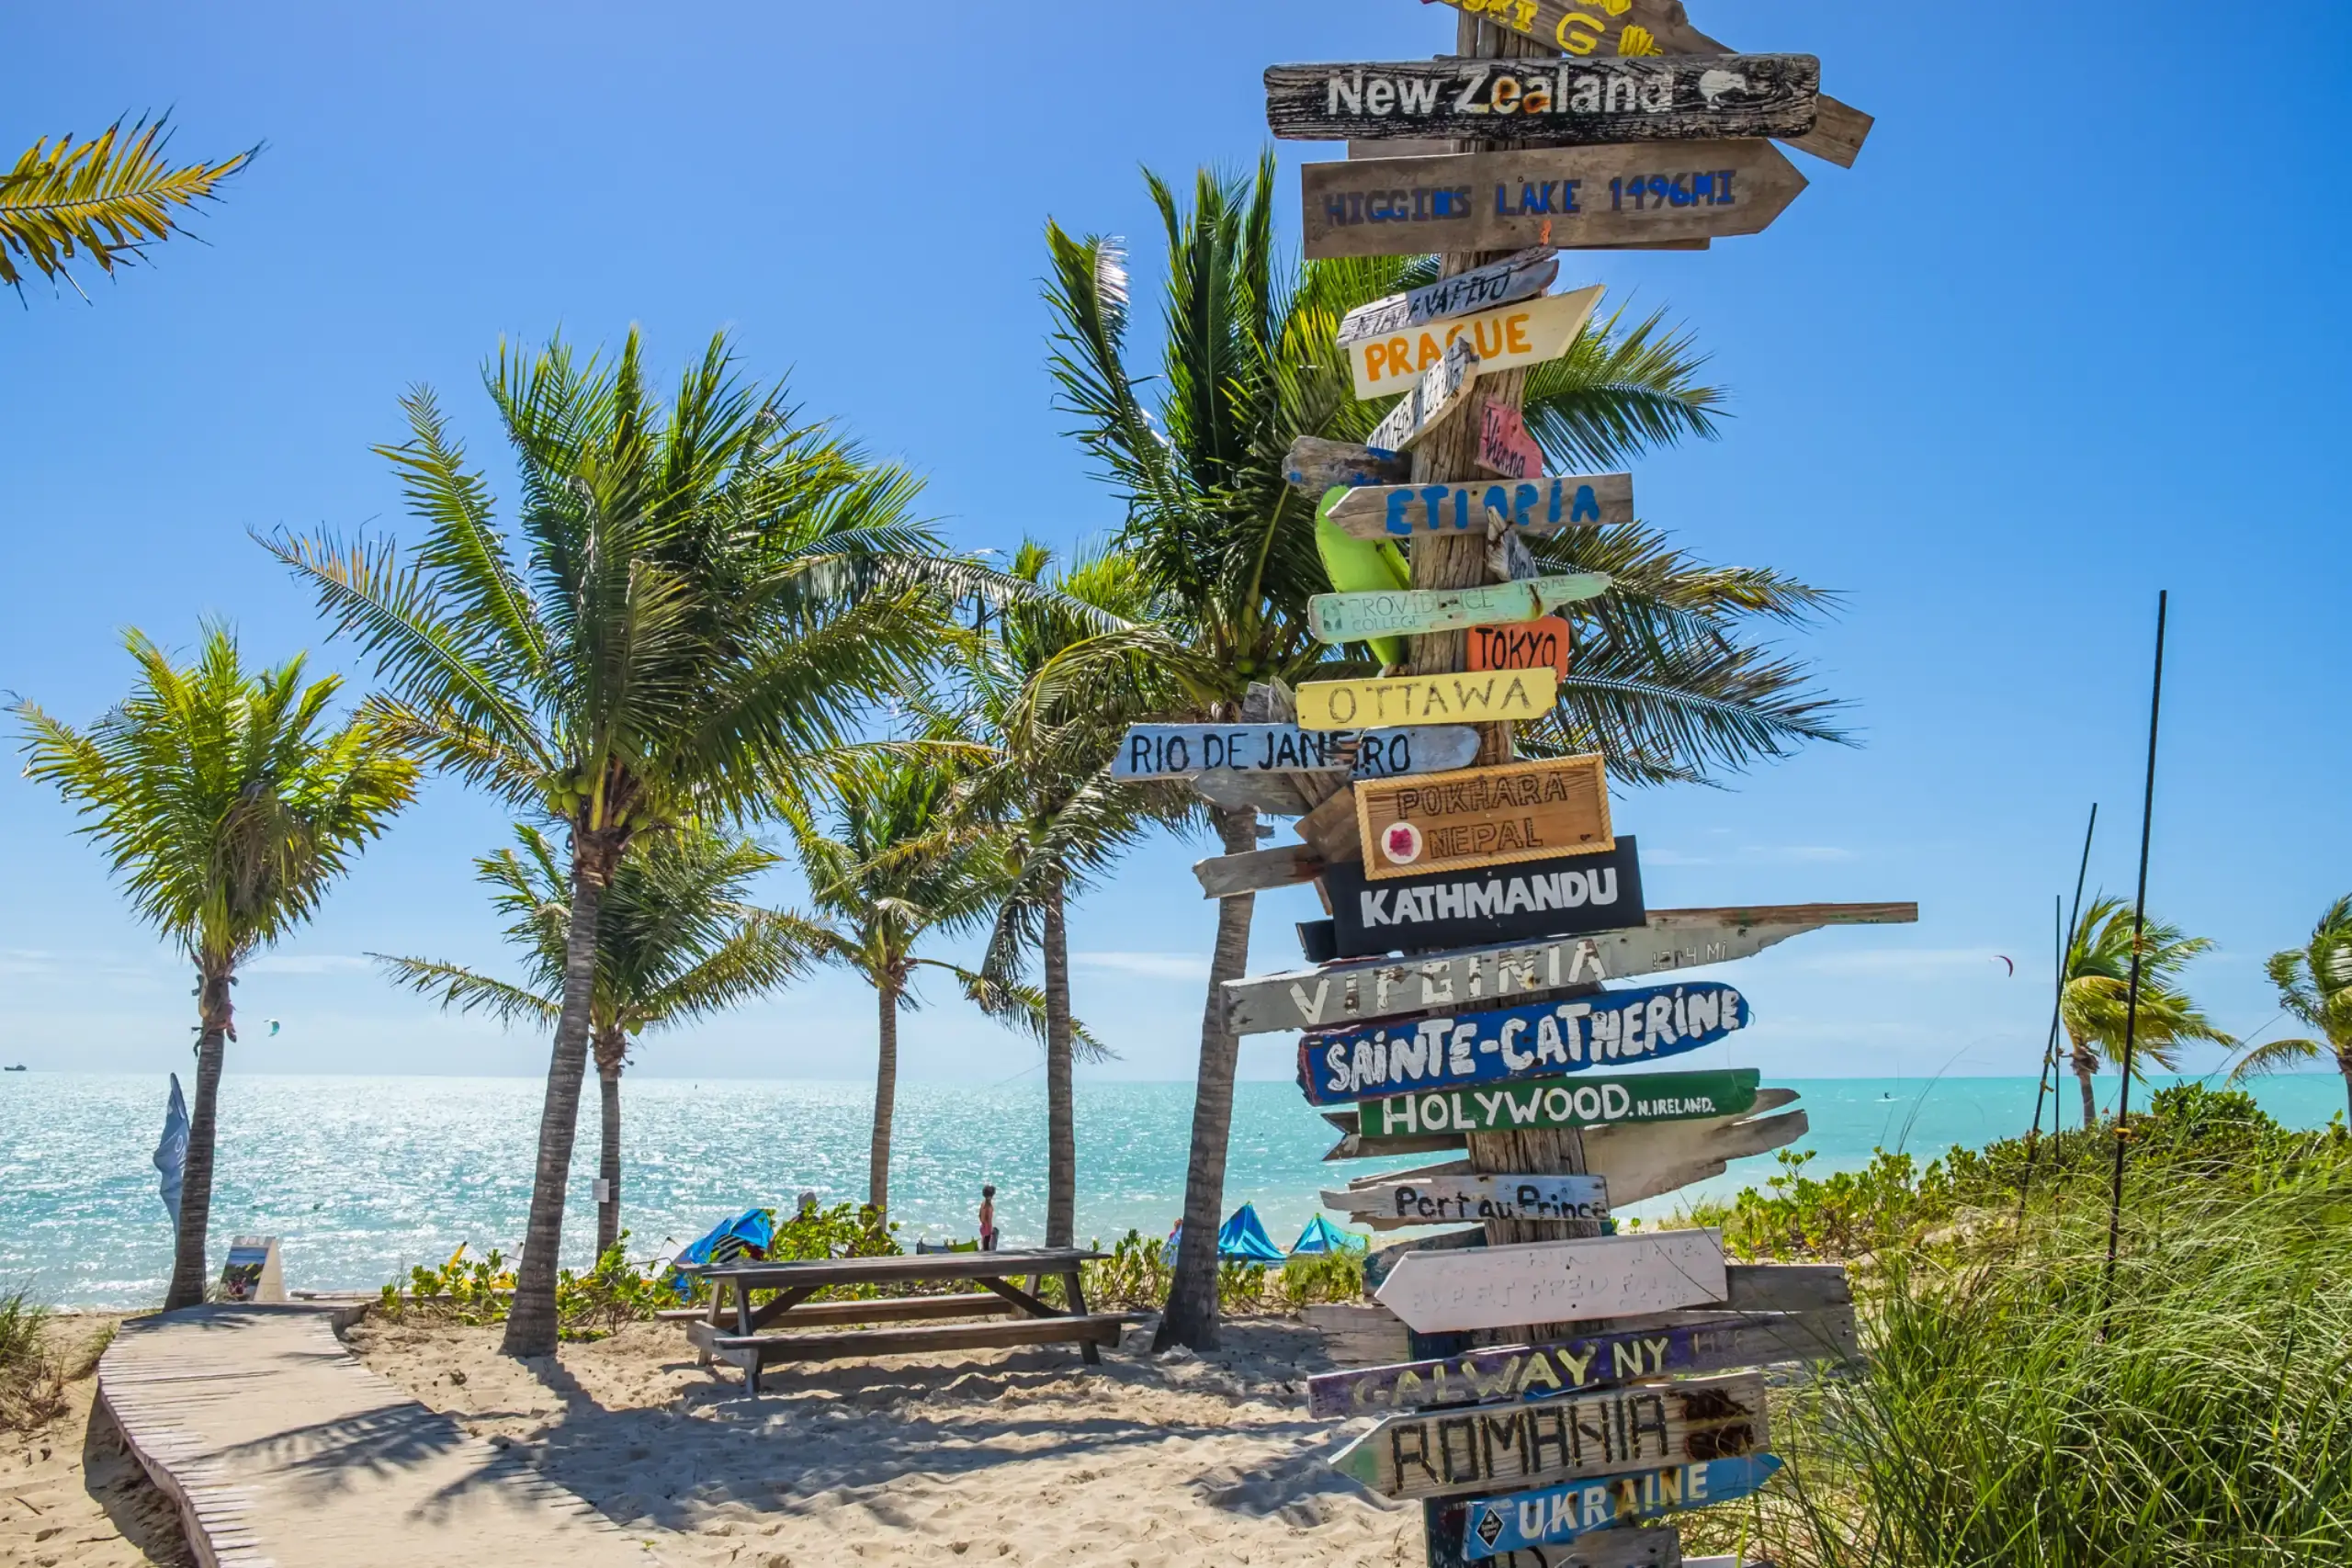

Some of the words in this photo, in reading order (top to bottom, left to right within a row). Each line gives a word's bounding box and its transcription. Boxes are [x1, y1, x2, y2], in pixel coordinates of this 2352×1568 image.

[1327, 69, 1439, 116] New
[1453, 63, 1674, 116] Zealand
[1323, 185, 1472, 227] HIGGINS
[1495, 179, 1582, 217] LAKE
[1517, 580, 1550, 597] 179
[1351, 614, 1423, 634] COLLEGE
[1475, 626, 1557, 671] TOKYO
[1328, 676, 1532, 725] OTTAWA
[1130, 733, 1191, 774] RIO
[1204, 733, 1247, 771] DE
[1396, 769, 1568, 820] POKHARA
[1428, 817, 1544, 860] NEPAL
[1360, 866, 1619, 929] KATHMANDU
[1395, 1185, 1469, 1219] Port
[1477, 1198, 1512, 1220] au
[1516, 1184, 1608, 1220] Prince
[1612, 1337, 1668, 1379] NY
[1390, 1393, 1669, 1493] ROMANIA
[1517, 1461, 1709, 1541] UKRAINE
